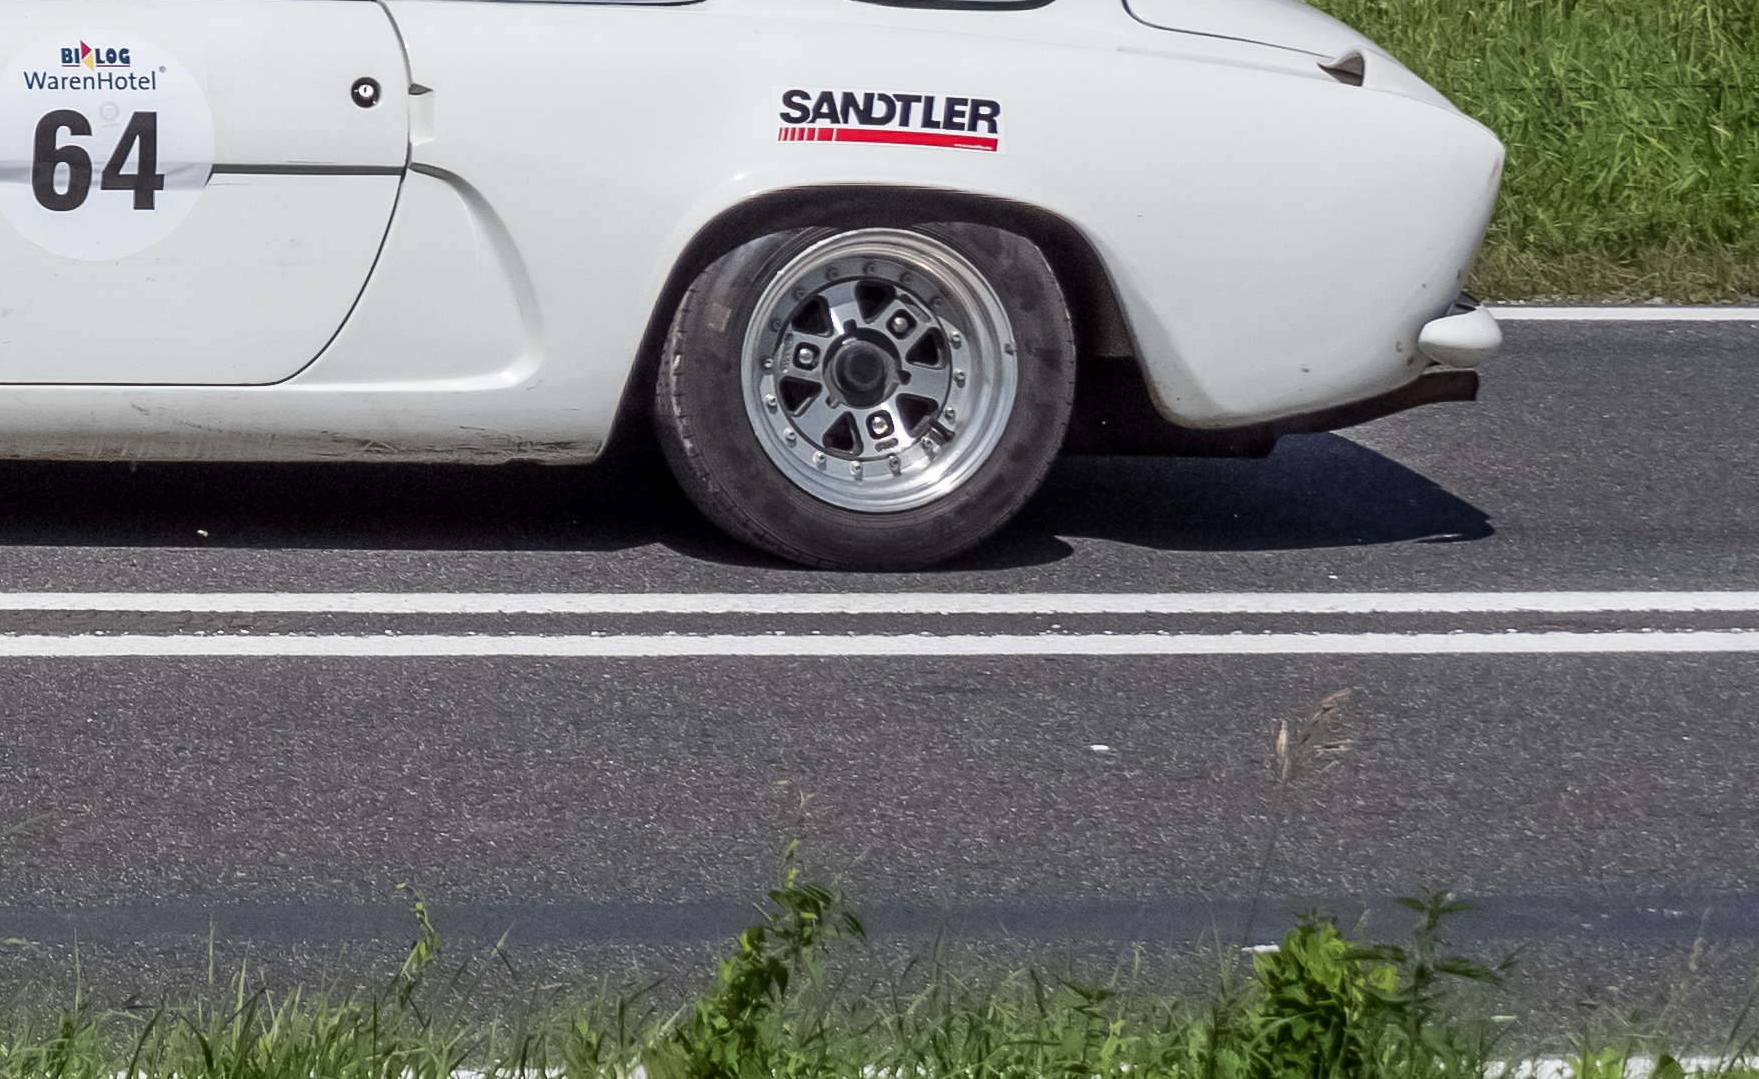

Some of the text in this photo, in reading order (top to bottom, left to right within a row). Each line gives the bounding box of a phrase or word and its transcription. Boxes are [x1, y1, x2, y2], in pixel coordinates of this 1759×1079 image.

[23, 70, 157, 91] WarenHotel
[778, 88, 1002, 135] SANDTLER
[30, 108, 166, 212] 64
